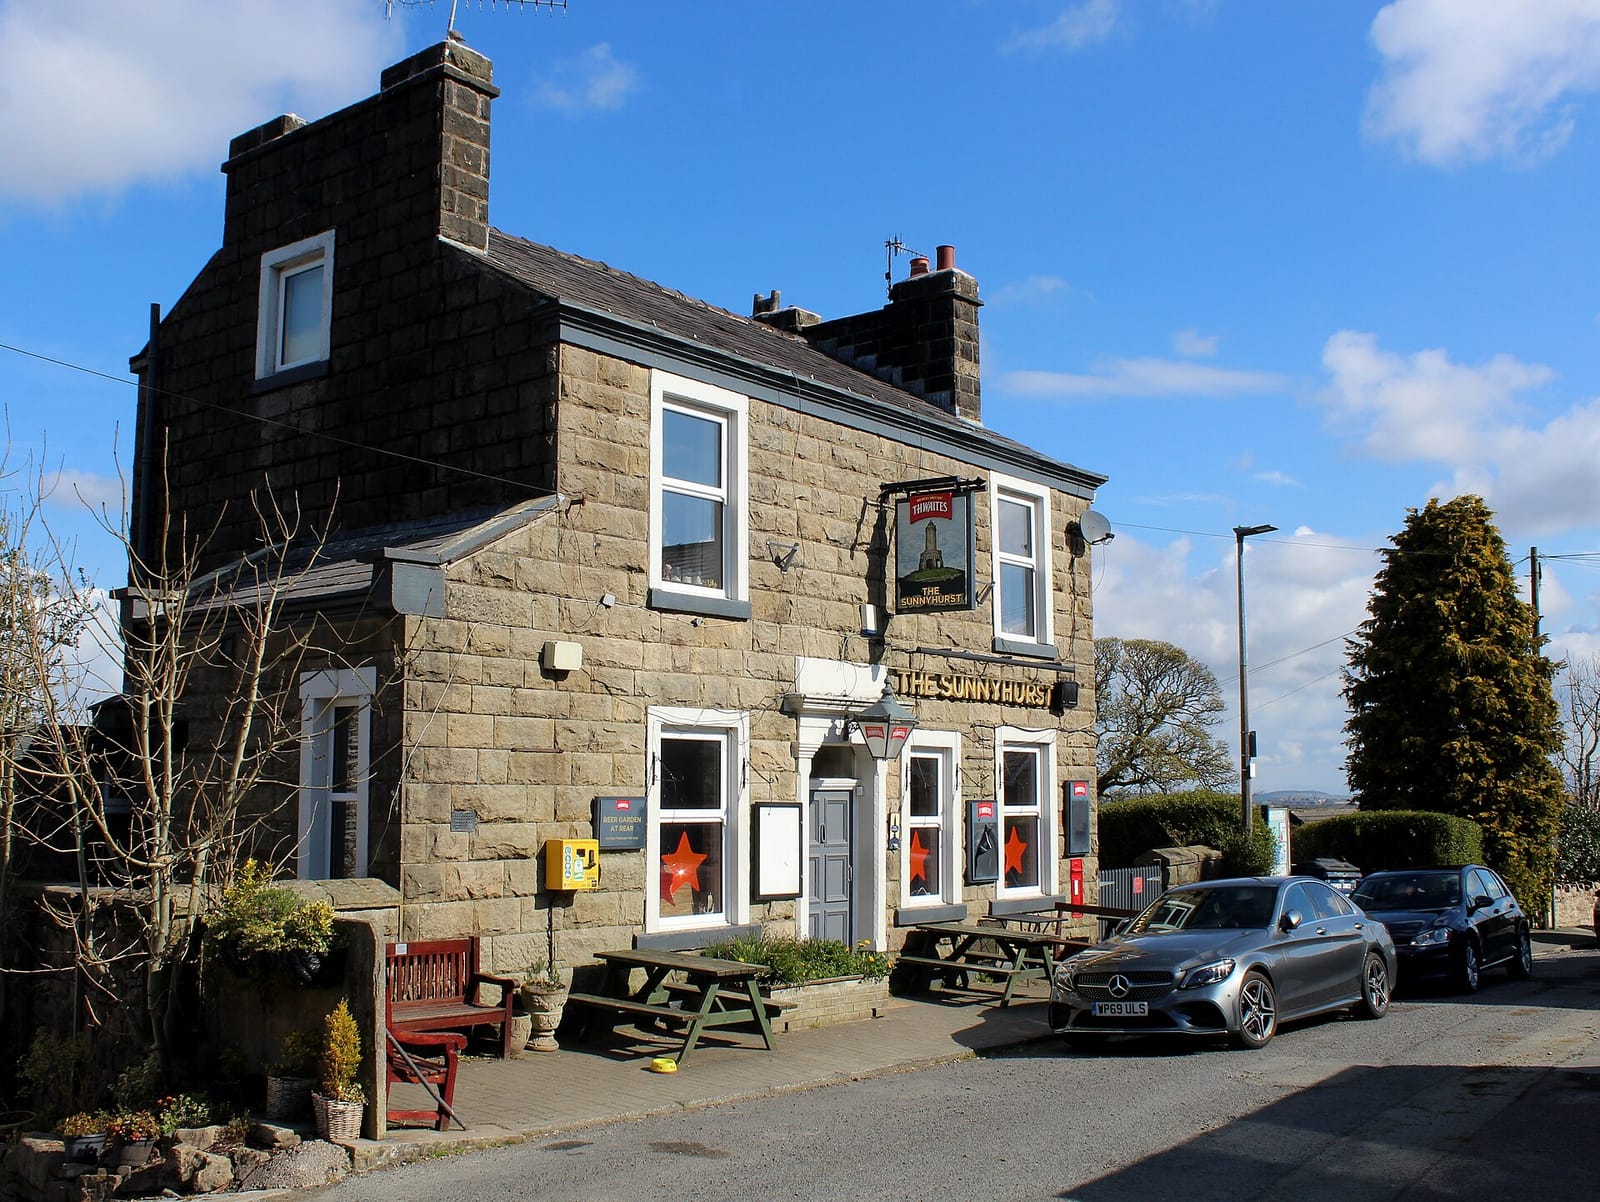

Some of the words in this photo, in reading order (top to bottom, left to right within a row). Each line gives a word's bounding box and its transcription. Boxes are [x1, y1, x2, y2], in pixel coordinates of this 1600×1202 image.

[912, 501, 948, 516] THWAITES
[922, 586, 940, 596] THE
[901, 594, 962, 606] SUNNYHURST
[899, 671, 941, 696] THE
[941, 675, 1054, 706] SUNNYHURST
[1125, 1003, 1146, 1015] ULS
